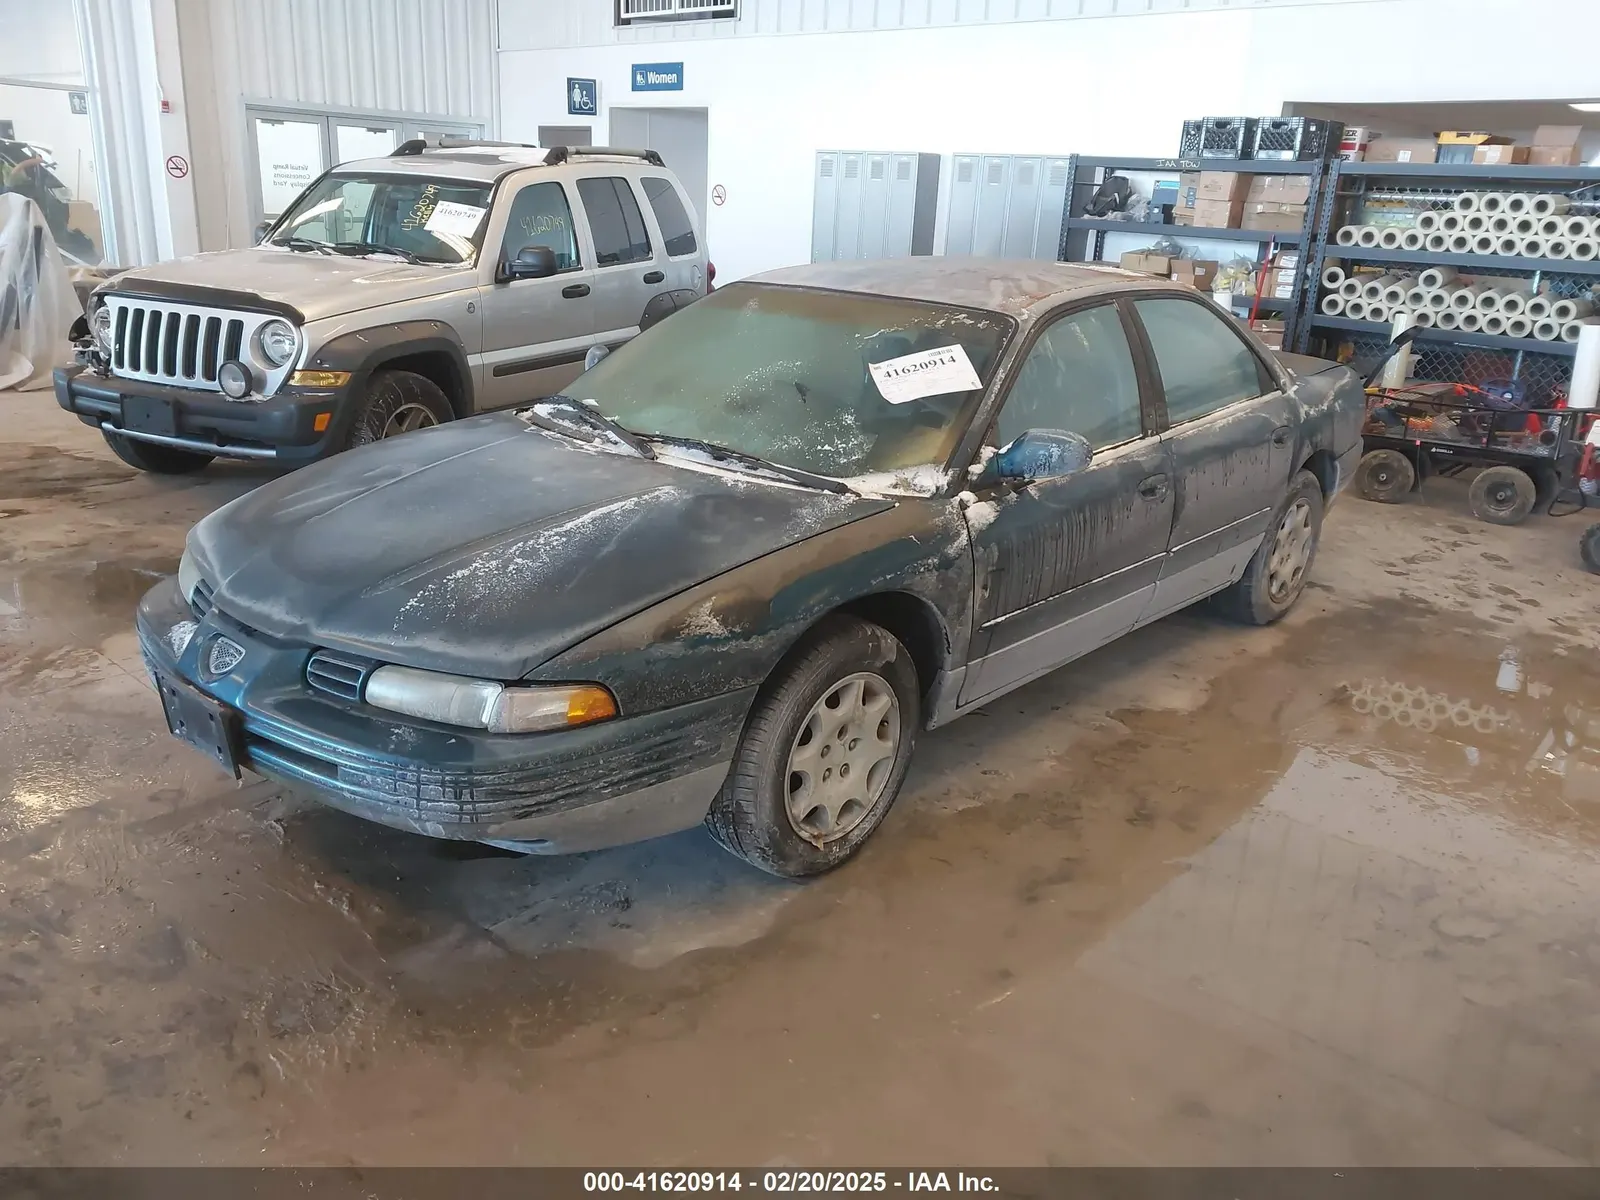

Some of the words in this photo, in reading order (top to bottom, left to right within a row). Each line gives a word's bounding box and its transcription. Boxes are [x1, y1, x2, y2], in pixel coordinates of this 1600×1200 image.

[647, 71, 678, 85] Women
[1156, 159, 1177, 168] IAA
[438, 207, 477, 220] 41620749
[884, 355, 956, 378] 41620914
